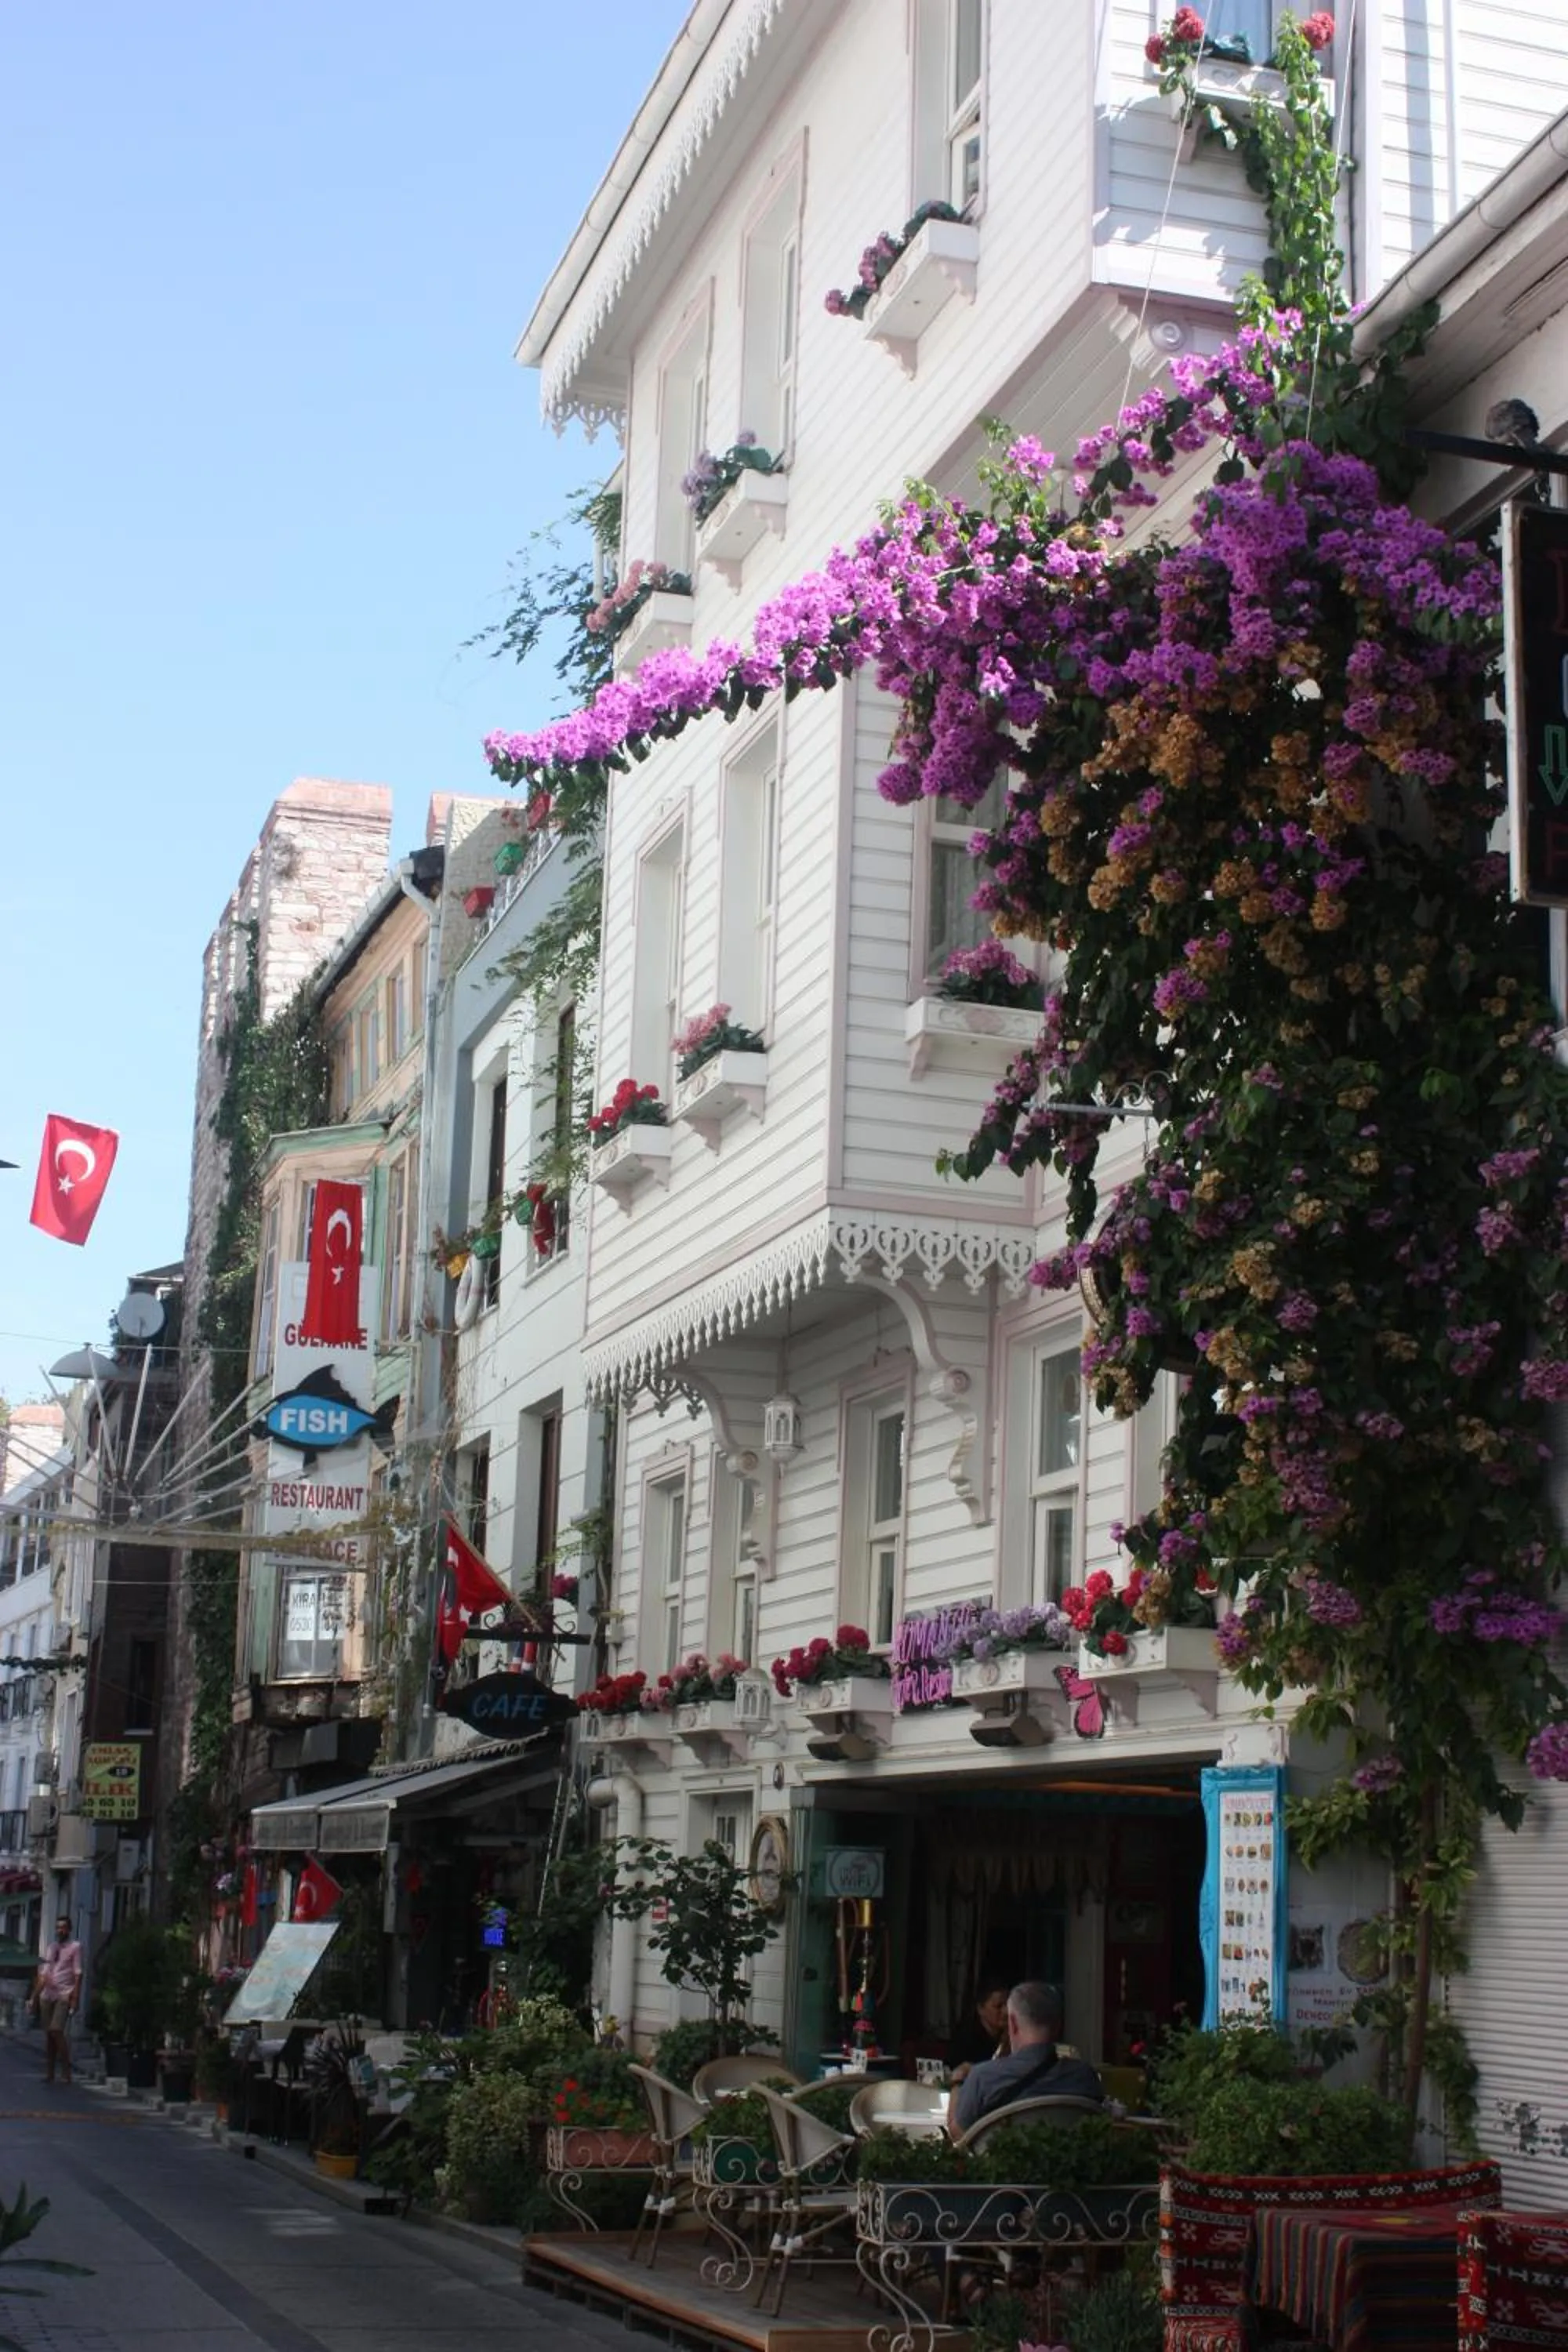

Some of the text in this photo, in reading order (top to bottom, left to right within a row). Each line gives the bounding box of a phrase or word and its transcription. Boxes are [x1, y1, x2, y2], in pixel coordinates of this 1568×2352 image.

[280, 1408, 347, 1434] FISH
[271, 1483, 363, 1511] RESTAURANT
[473, 1693, 546, 1720] CAFE
